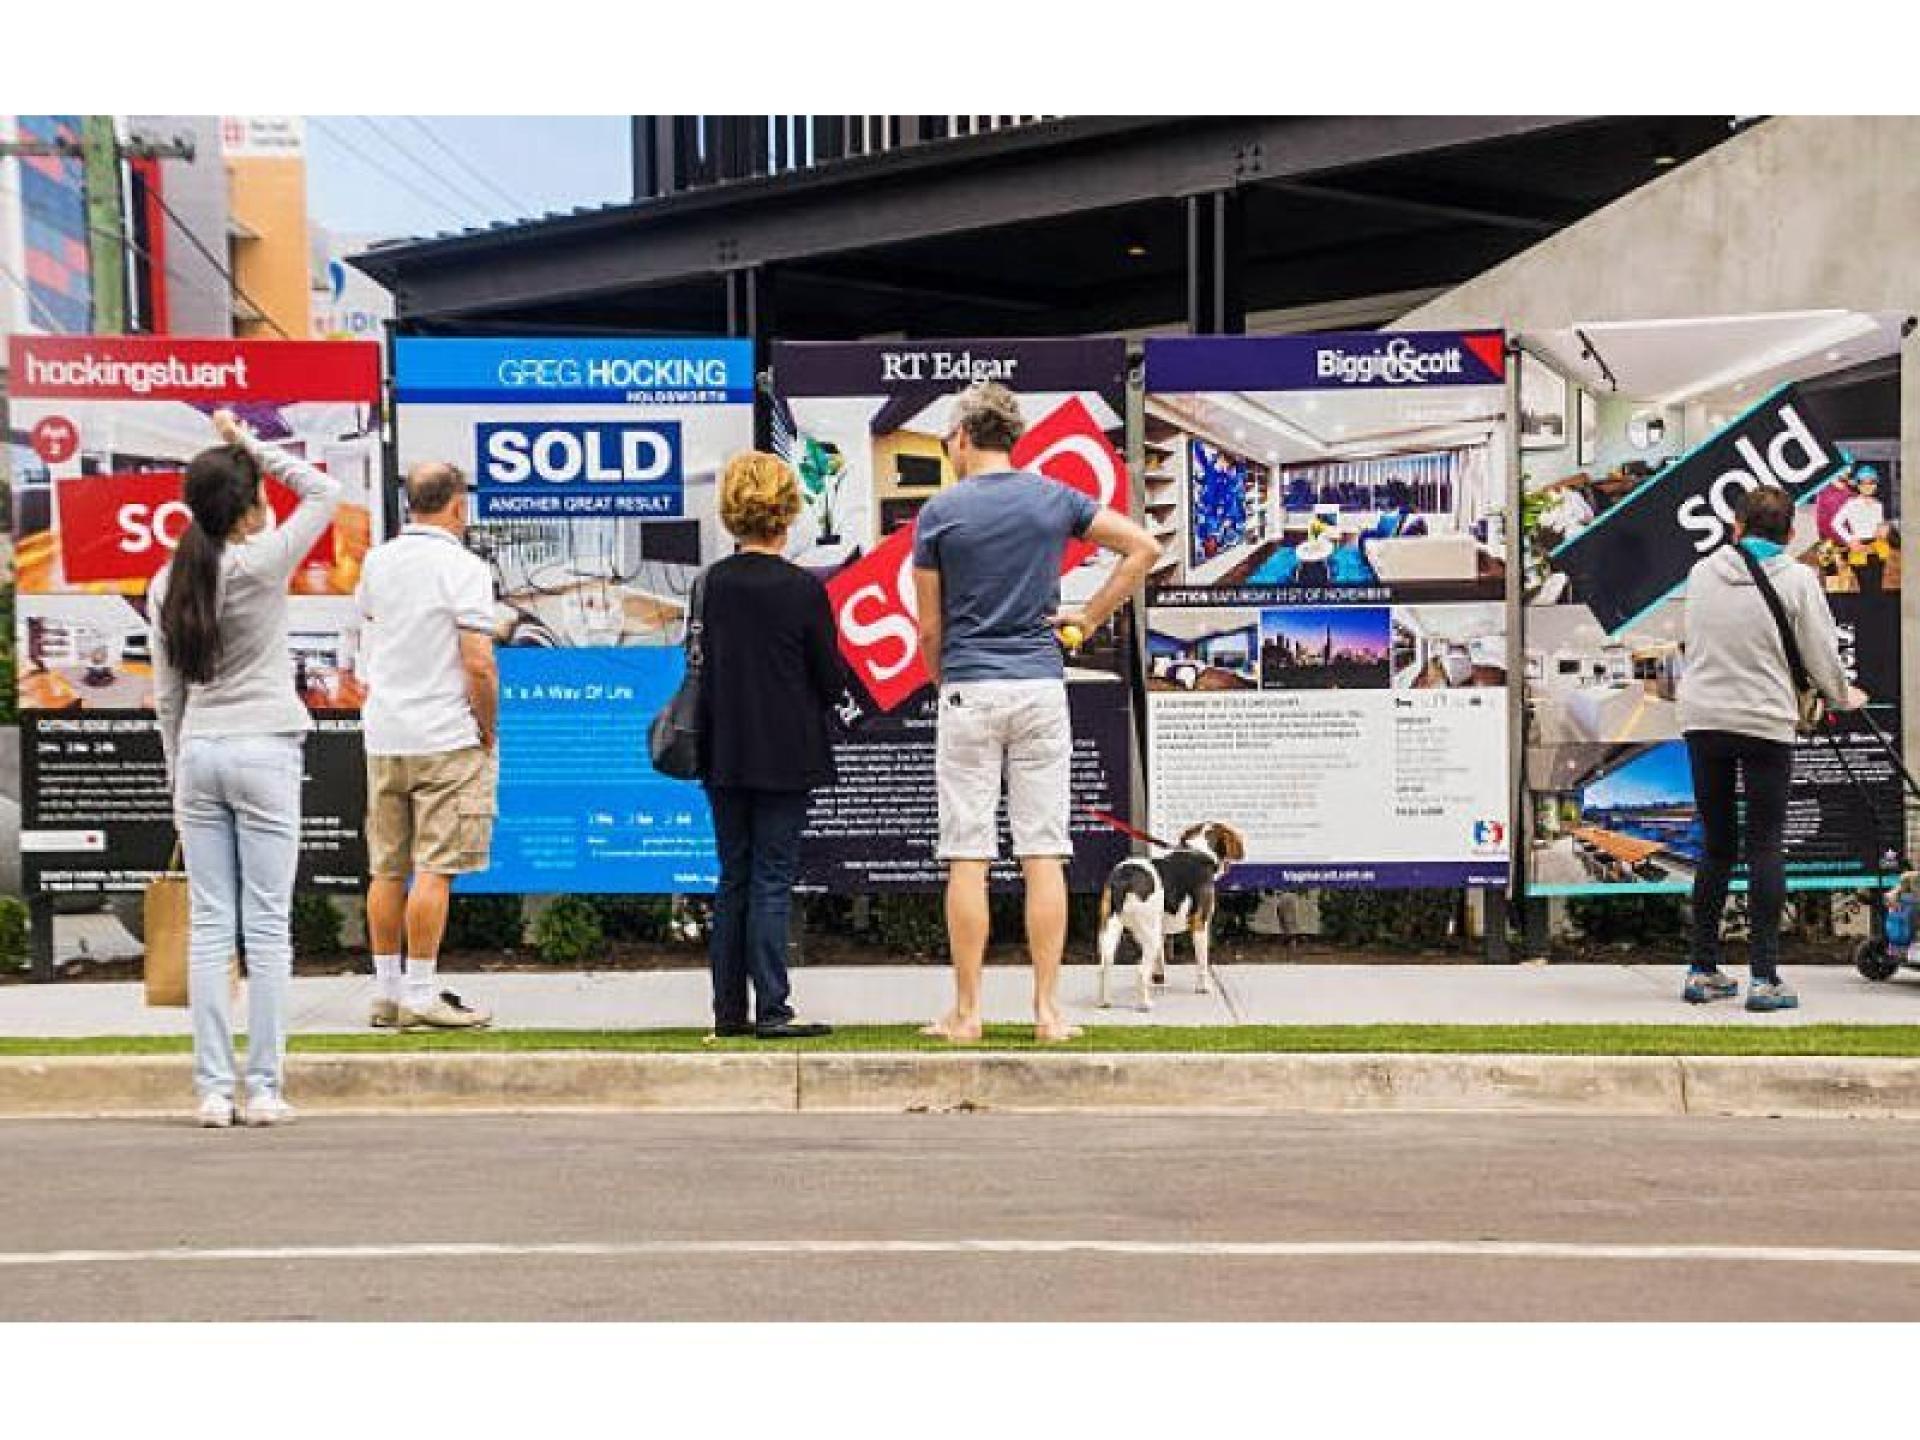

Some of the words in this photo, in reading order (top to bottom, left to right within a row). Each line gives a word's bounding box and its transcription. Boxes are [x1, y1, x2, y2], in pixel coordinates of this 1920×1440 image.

[25, 352, 248, 392] hockingstuart
[498, 359, 581, 385] GREG
[588, 359, 727, 386] HOCKING
[880, 352, 928, 380] RT
[930, 351, 1018, 384] Edgar
[488, 431, 673, 483] SOLD
[489, 496, 561, 513] ANOTHER
[563, 496, 612, 512] GREAT
[614, 496, 673, 512] RESULT
